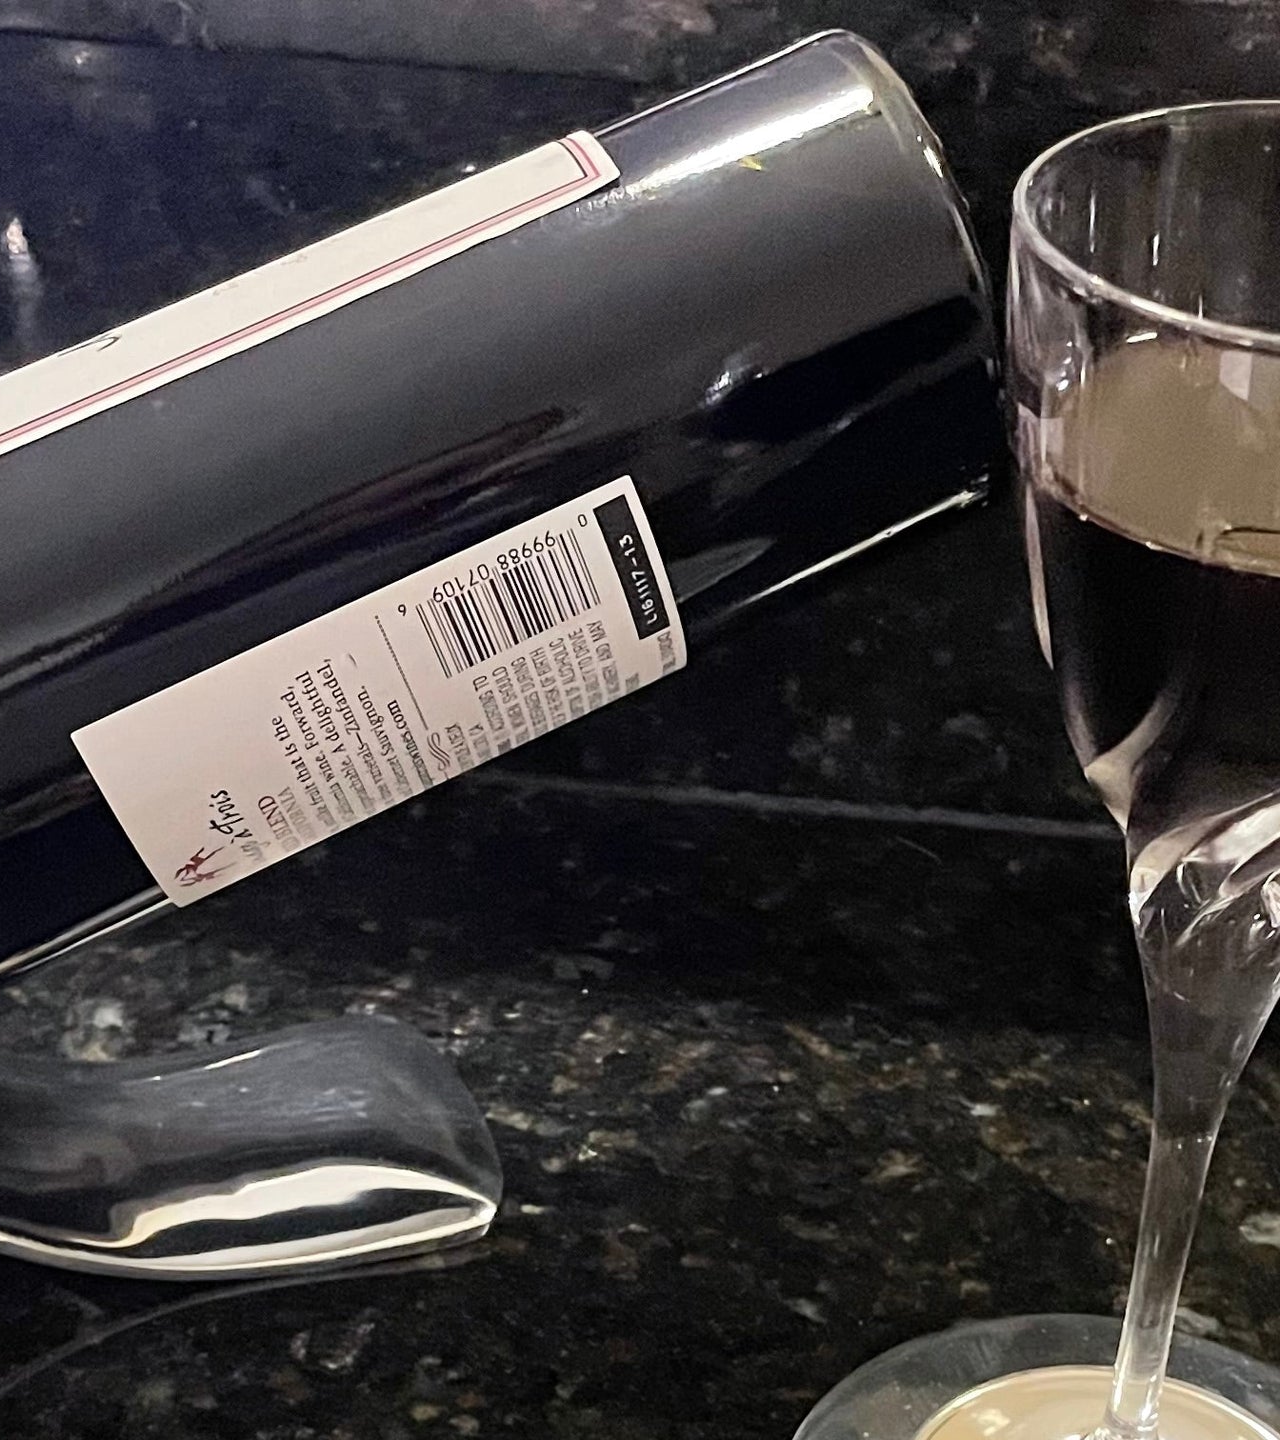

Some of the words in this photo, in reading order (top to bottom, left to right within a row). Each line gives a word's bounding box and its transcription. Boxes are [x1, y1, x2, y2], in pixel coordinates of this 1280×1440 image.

[577, 513, 587, 527] 0
[496, 530, 555, 570] 99988
[432, 563, 490, 603] 07109
[397, 603, 406, 616] 6
[586, 620, 606, 642] MAY
[529, 646, 551, 676] BIRTH
[548, 637, 575, 685] ALCOHOLIC
[472, 675, 489, 691] TO
[492, 666, 517, 704] SHOULD
[280, 685, 318, 749] Forward,
[295, 670, 339, 741] delightful
[357, 685, 394, 755] Sauvignon.
[271, 715, 290, 741] the
[284, 742, 298, 756] is
[332, 742, 346, 753] A
[290, 756, 311, 782] that
[209, 789, 243, 834] Trois
